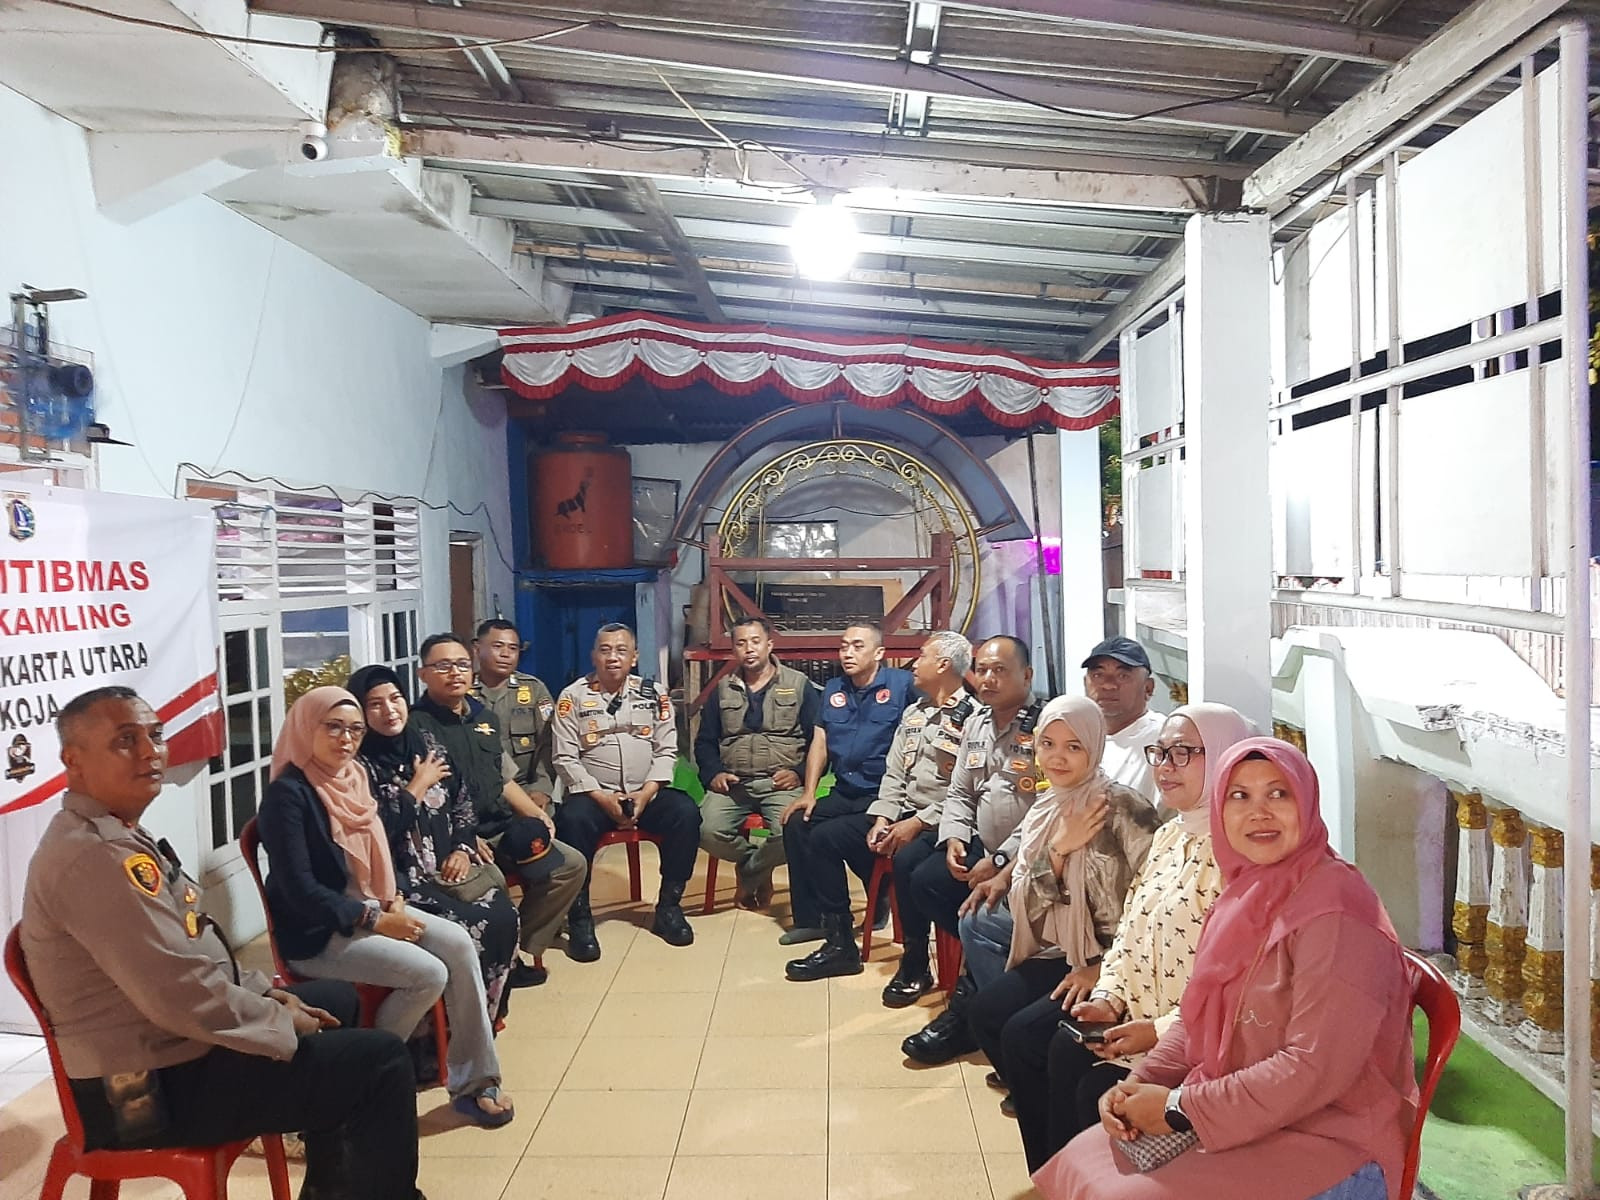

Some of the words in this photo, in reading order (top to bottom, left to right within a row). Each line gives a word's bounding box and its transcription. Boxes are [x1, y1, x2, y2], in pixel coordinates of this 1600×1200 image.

[0, 559, 149, 594] TIBMAS
[0, 603, 131, 636] KAMLING
[0, 650, 76, 688] KARTA
[80, 642, 148, 676] UTARA
[0, 693, 60, 731] KOJA
